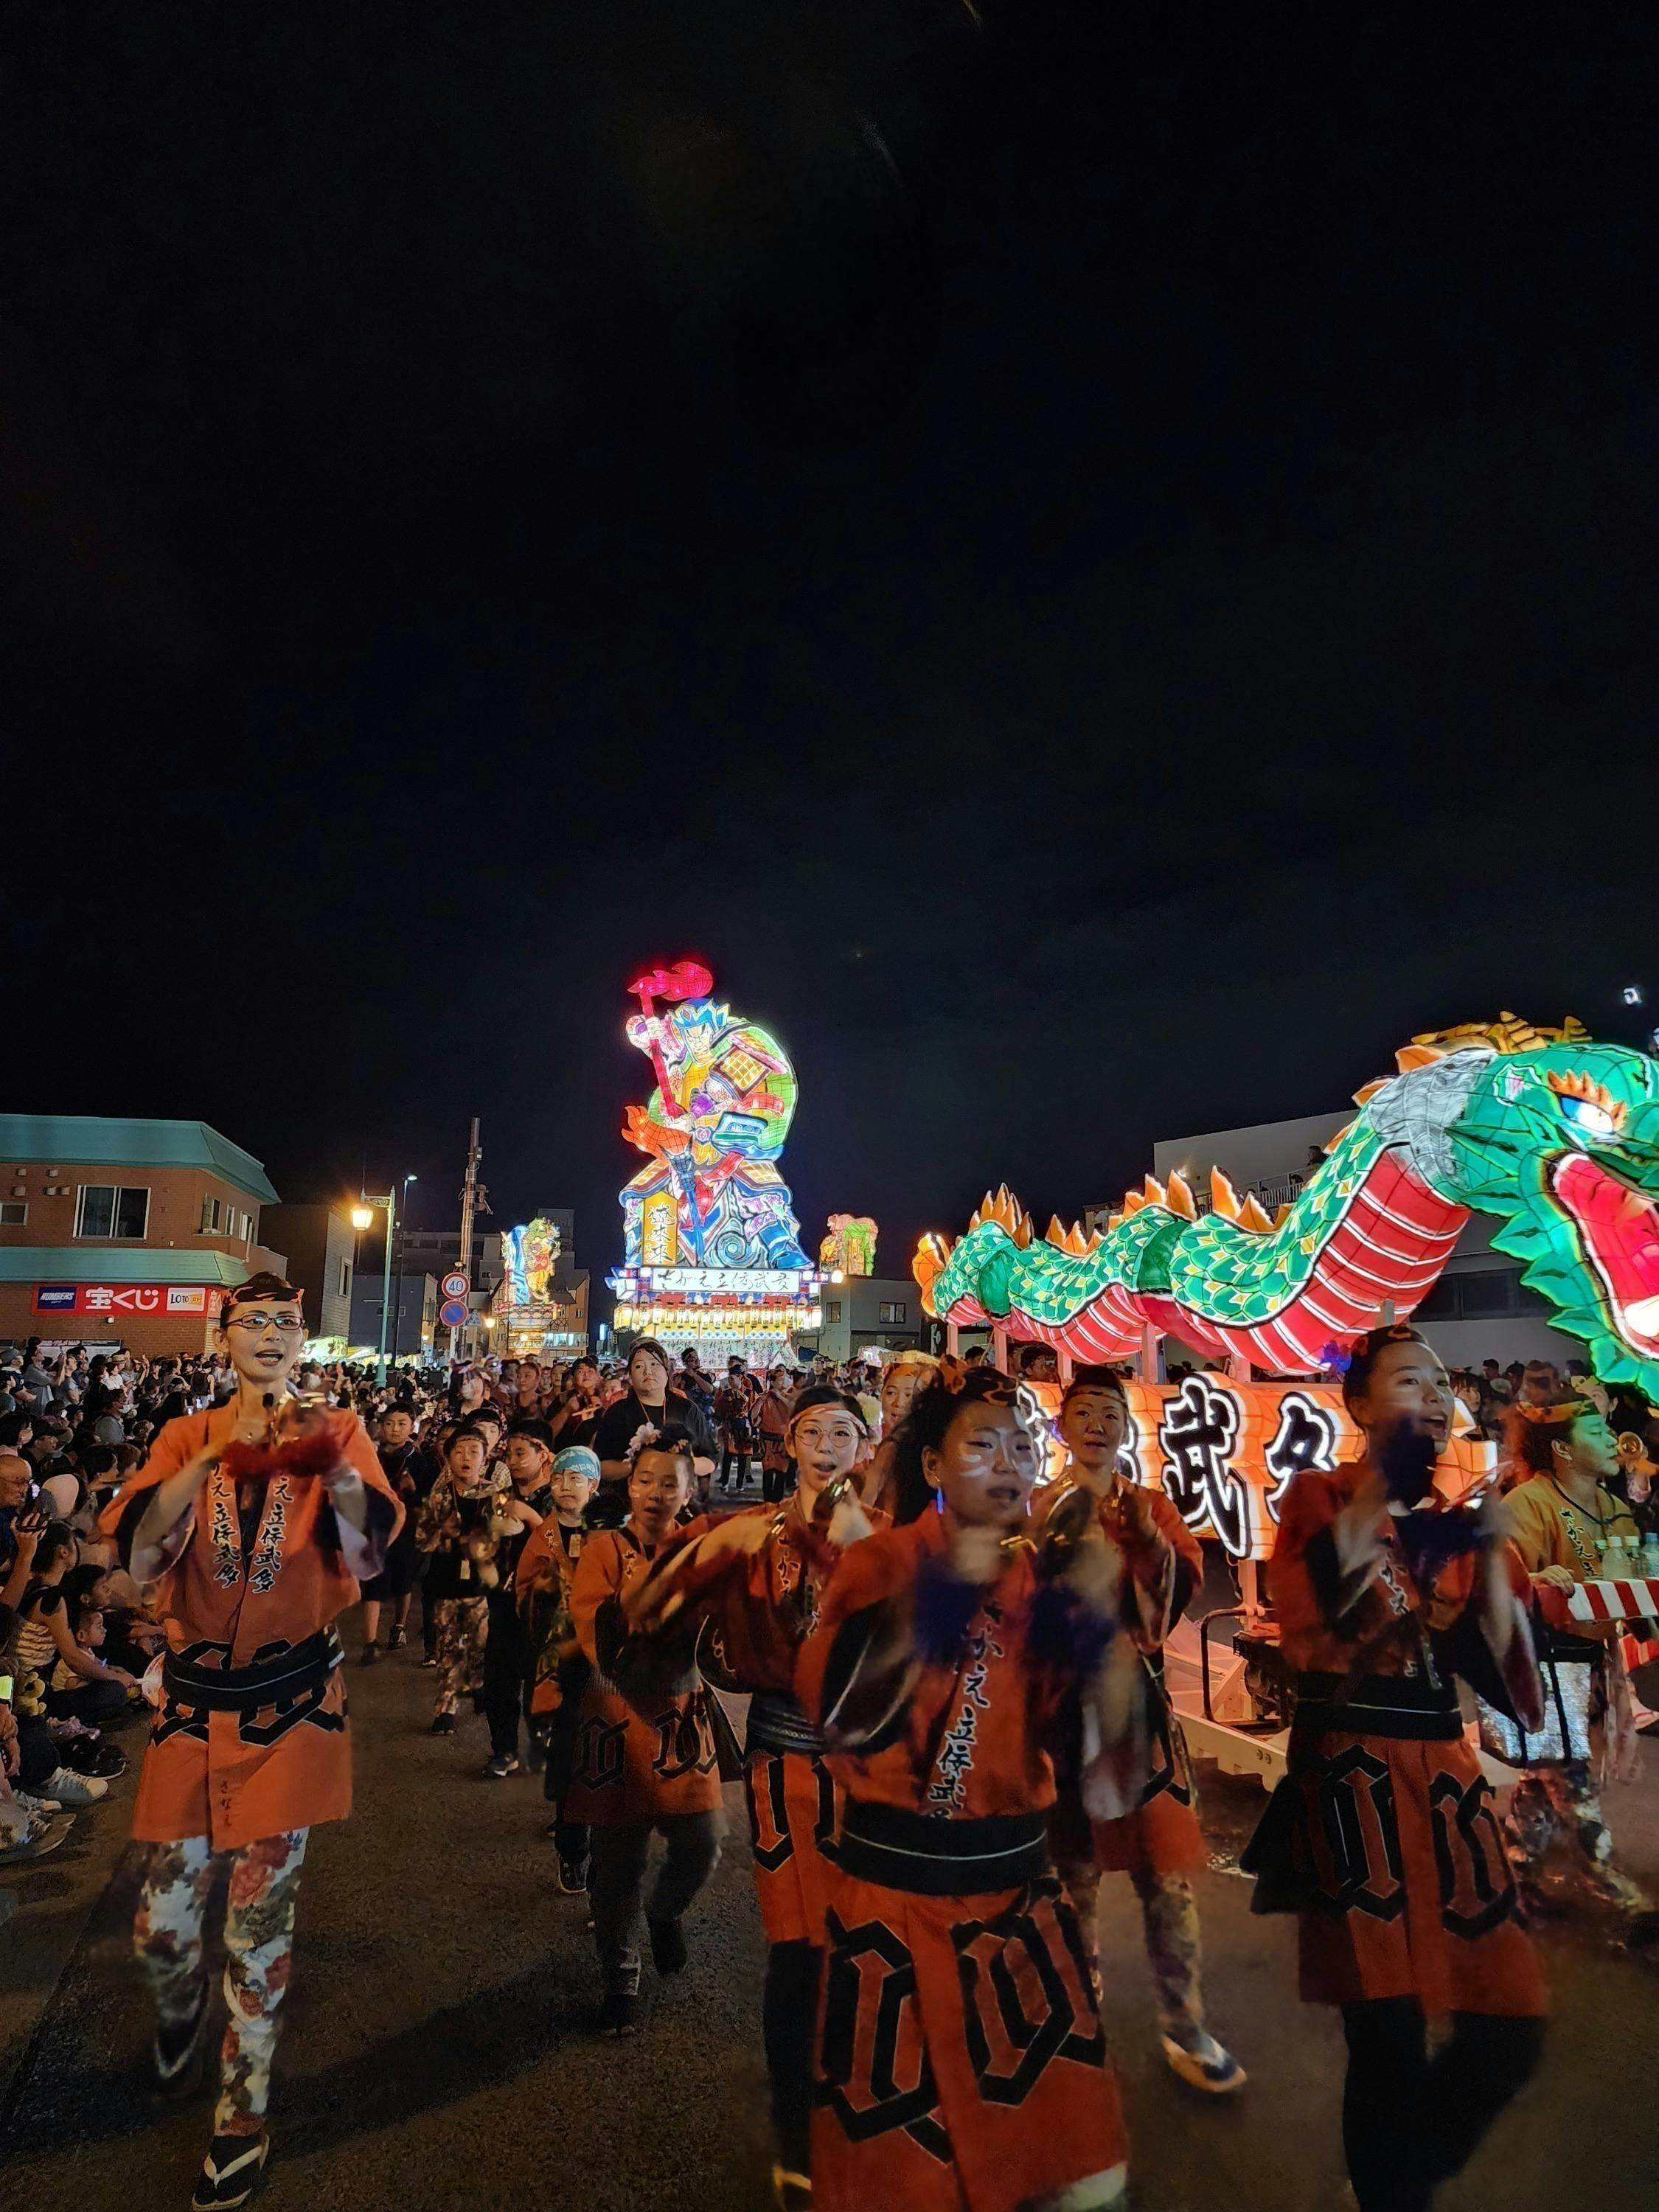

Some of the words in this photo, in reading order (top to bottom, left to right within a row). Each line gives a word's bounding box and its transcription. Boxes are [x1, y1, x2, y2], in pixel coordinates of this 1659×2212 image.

[448, 1280, 464, 1292] 40
[40, 1292, 74, 1301] NUMBERS
[86, 1287, 159, 1310] 宝くじ
[170, 1293, 189, 1304] LOTO
